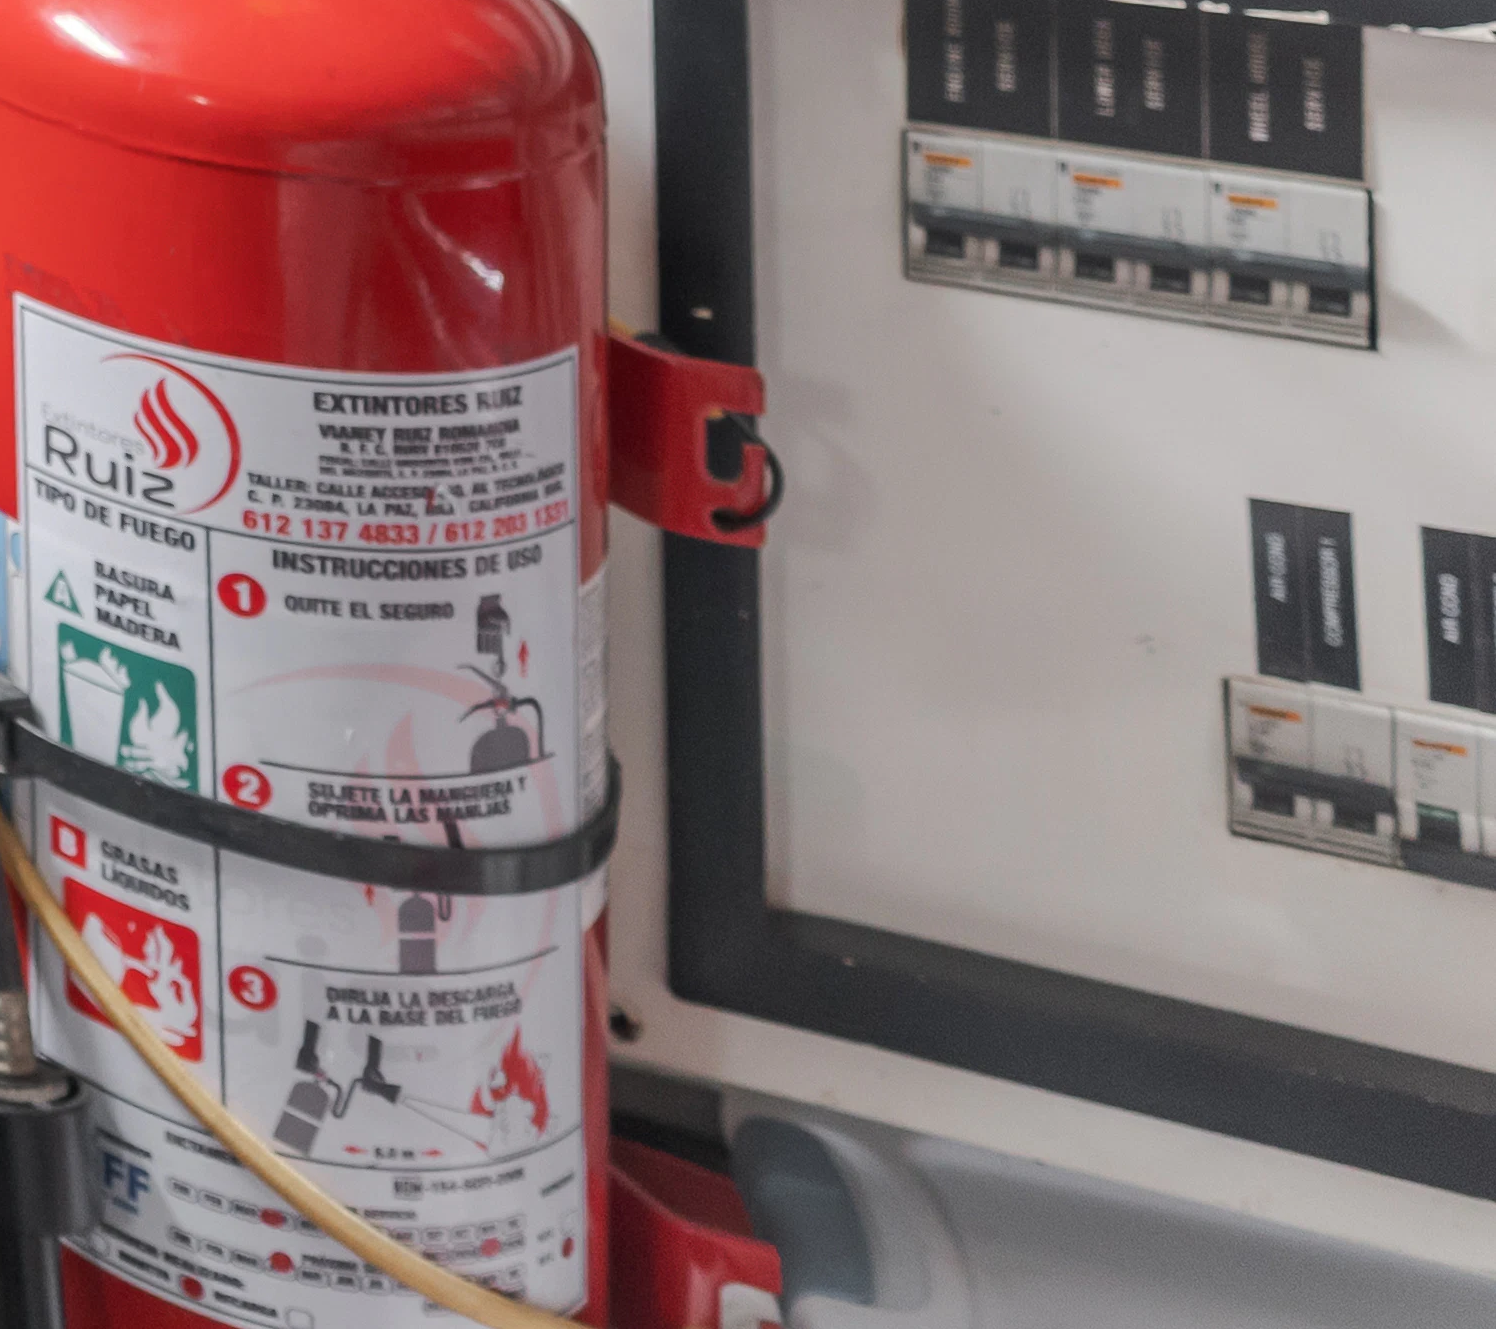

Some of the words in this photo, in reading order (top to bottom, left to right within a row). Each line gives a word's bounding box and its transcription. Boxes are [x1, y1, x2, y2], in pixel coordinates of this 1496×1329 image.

[313, 391, 470, 417] EXTINTORES
[476, 386, 524, 412] RUIZ
[45, 424, 176, 508] Ruiz
[34, 477, 77, 514] TIPO
[83, 498, 112, 528] DE
[119, 511, 197, 552] FUEGO
[242, 509, 293, 537] 612
[302, 517, 350, 542] 137
[358, 523, 421, 546] 4833
[443, 519, 486, 543] 612
[272, 547, 469, 583] INSTRUCCIONES
[474, 554, 502, 578] DE
[507, 542, 544, 572] USO
[94, 582, 157, 622] PAPEL
[283, 593, 343, 619] QUITE
[348, 600, 377, 621] EL
[378, 601, 456, 622] SEGURO
[95, 605, 183, 652] MADERA
[236, 771, 261, 804] 2
[307, 780, 383, 806] SUJETE
[388, 787, 413, 806] LA
[418, 779, 514, 806] MANGUERA
[307, 800, 388, 824] OPRIMA
[394, 805, 430, 825] LAS
[100, 838, 180, 887] GRASAS
[241, 972, 265, 1005] 3
[397, 991, 423, 1010] LA
[325, 1004, 341, 1022] A
[346, 1007, 374, 1026] LA
[378, 1009, 429, 1027] BASE
[434, 1005, 467, 1027] DEL
[472, 996, 523, 1021] FUEGO
